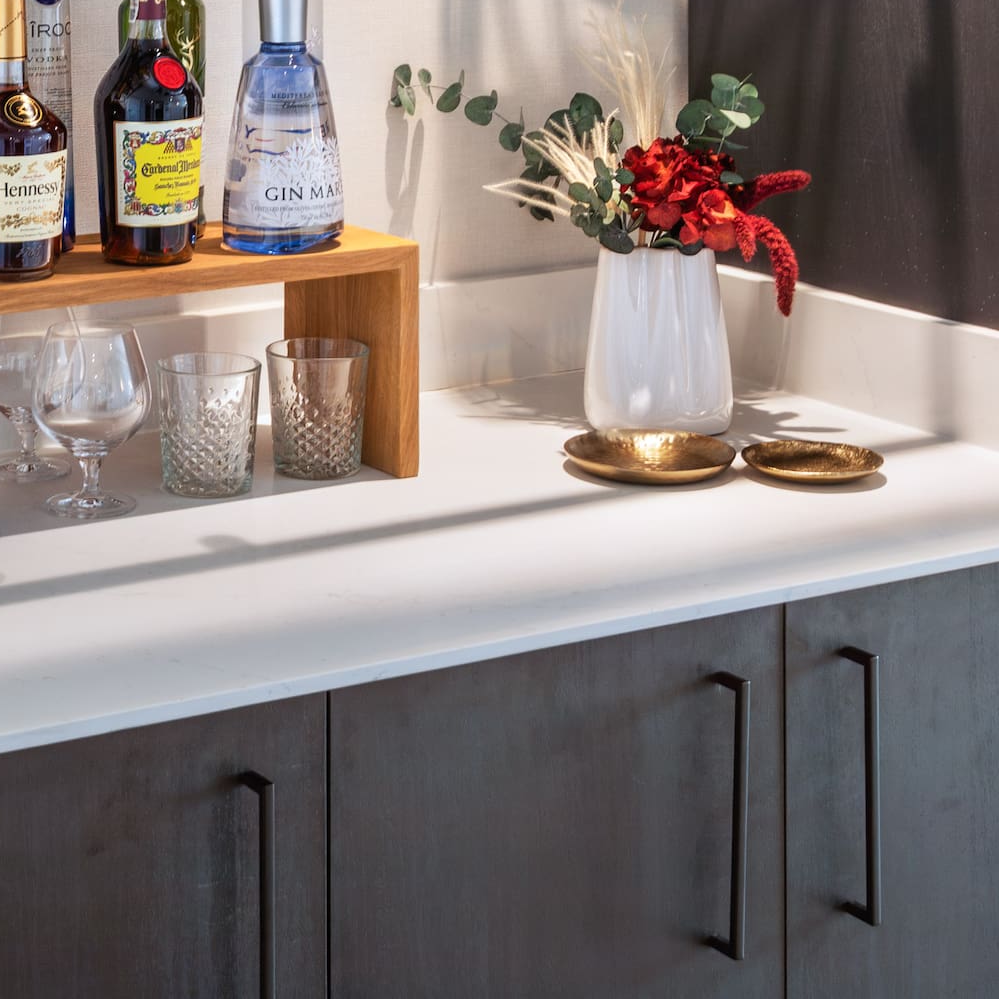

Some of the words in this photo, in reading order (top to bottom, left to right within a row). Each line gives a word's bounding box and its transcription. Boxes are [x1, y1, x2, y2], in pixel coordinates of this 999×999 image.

[27, 55, 68, 63] VODKA
[141, 162, 178, 178] Cardenal
[265, 186, 303, 201] GIN
